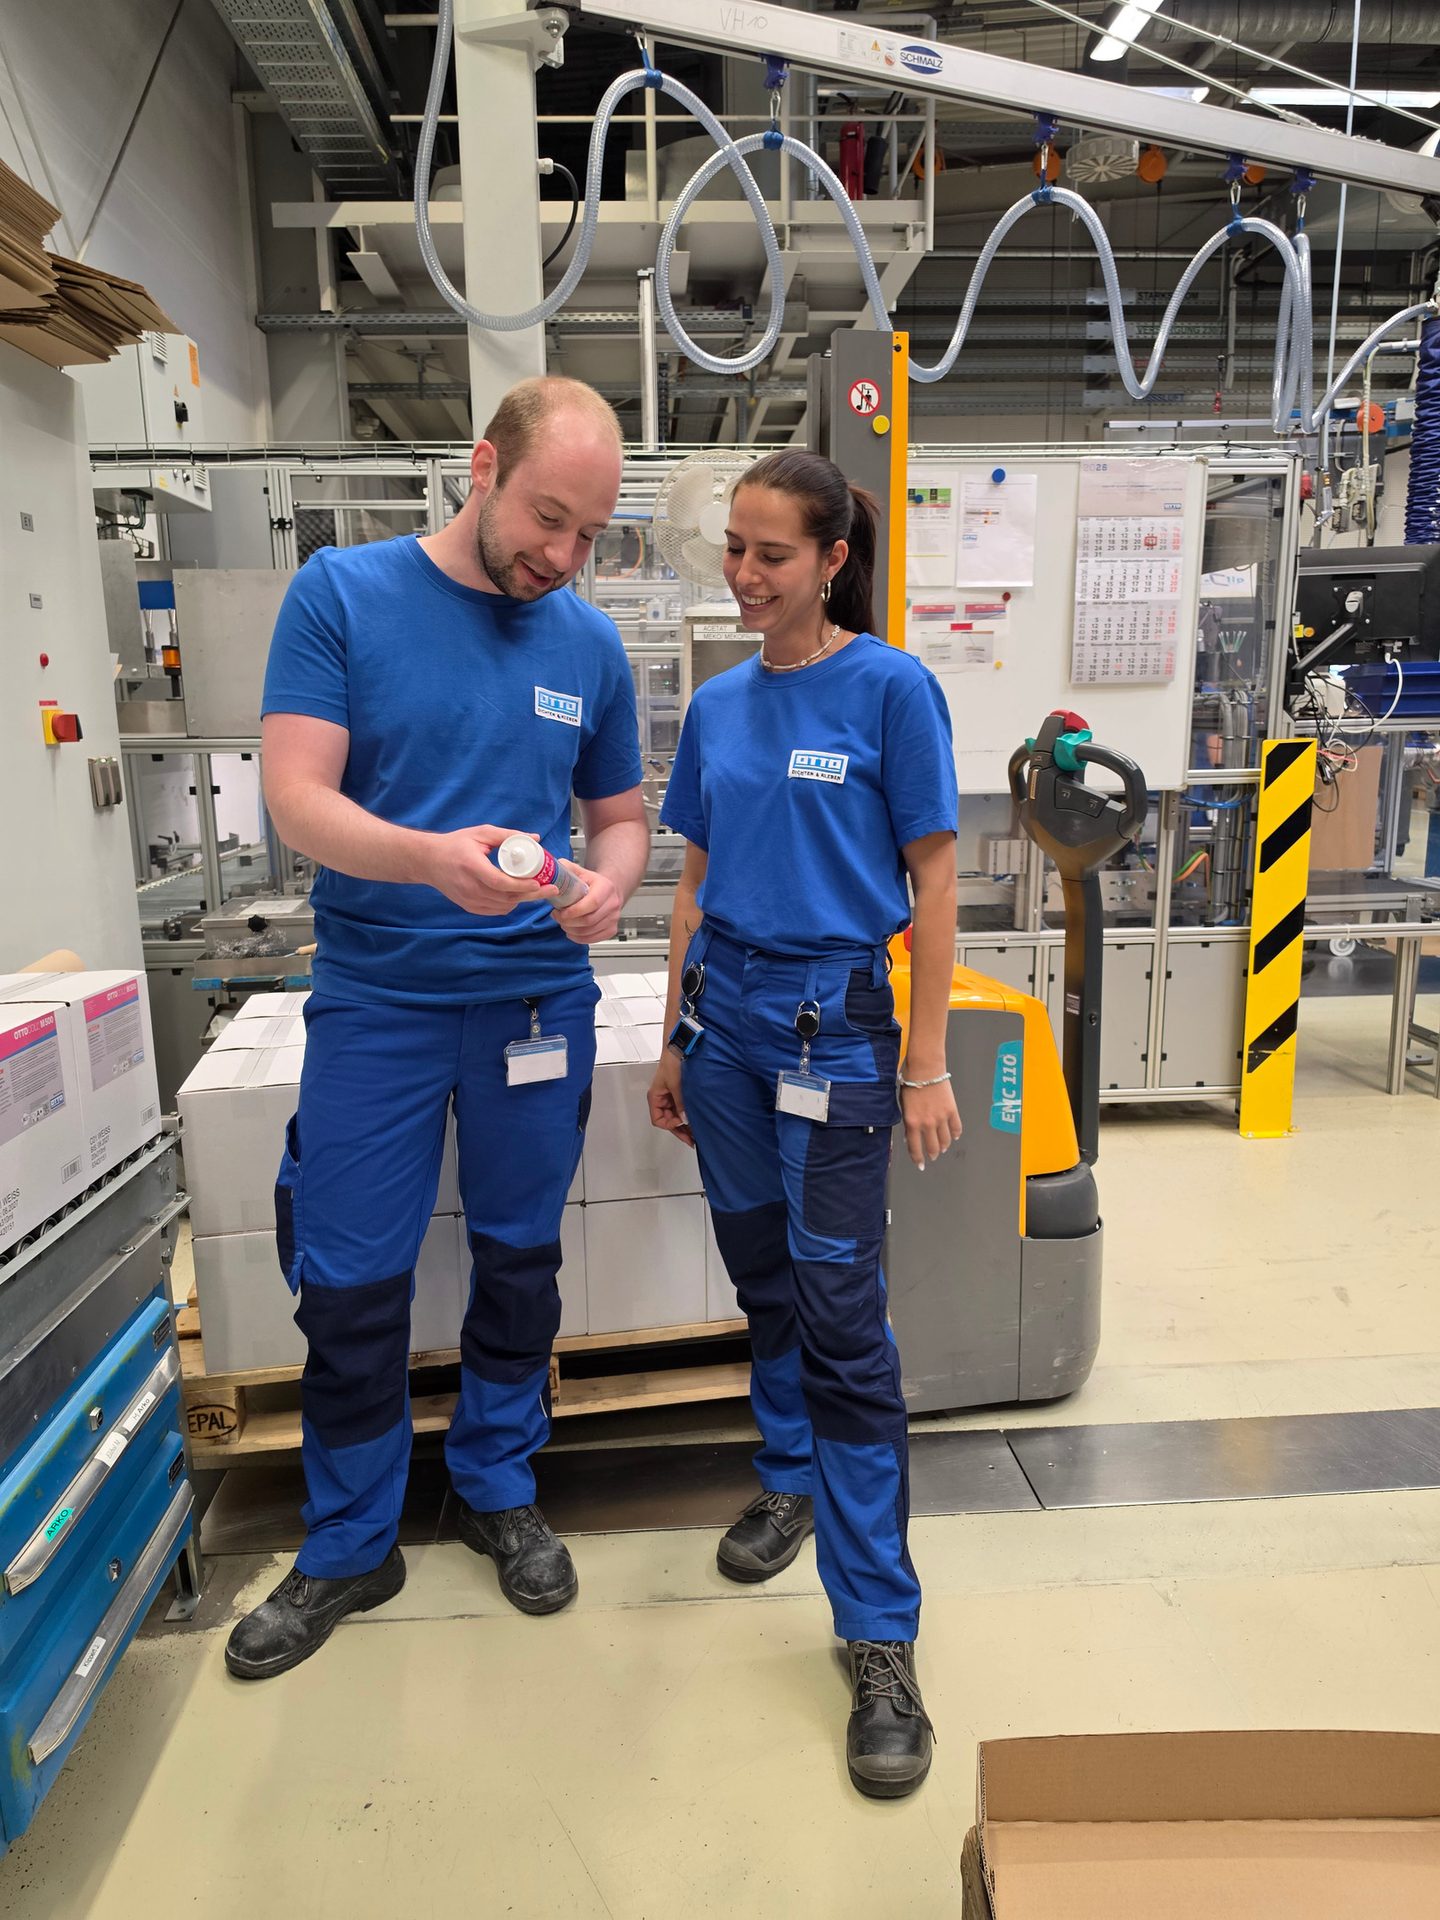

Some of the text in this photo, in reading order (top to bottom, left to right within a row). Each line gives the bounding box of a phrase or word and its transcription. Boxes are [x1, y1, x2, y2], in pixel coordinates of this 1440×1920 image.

[900, 51, 944, 69] SCHMALZ
[540, 693, 578, 713] OTTO
[796, 755, 842, 770] OTTO
[820, 773, 842, 781] KLEBEN
[1002, 1054, 1017, 1123] EMC 110
[98, 1125, 111, 1140] WEISS
[2, 1188, 20, 1206] WEISS
[188, 1412, 232, 1433] EPAL
[46, 1509, 69, 1536] ARKO
